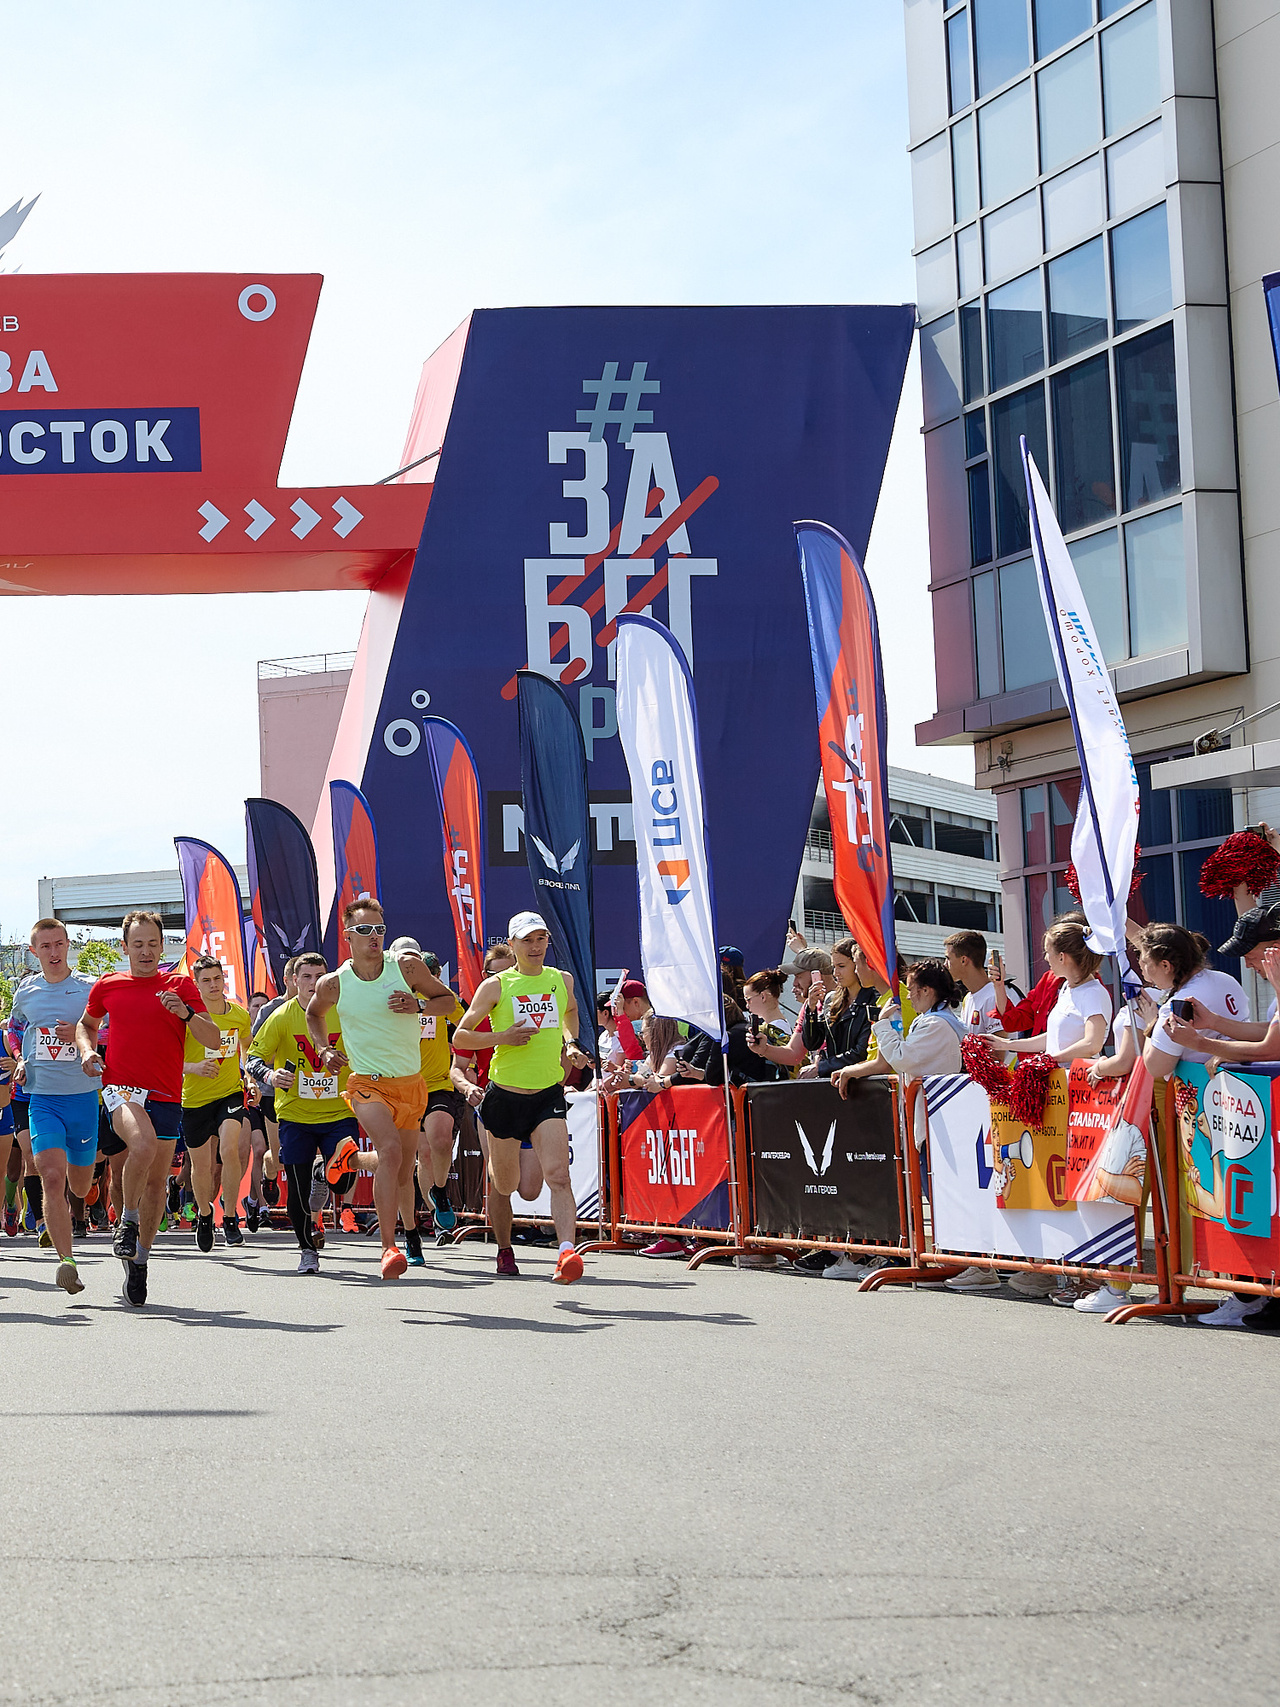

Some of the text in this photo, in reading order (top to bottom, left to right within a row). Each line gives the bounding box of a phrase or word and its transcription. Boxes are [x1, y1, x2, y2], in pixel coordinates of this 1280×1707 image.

[548, 431, 692, 555] ЗА
[518, 1002, 554, 1014] 20045
[302, 1077, 335, 1087] 30402
[1068, 1111, 1111, 1130] СТАЛЬГРАД
[1068, 1135, 1089, 1150] ЕЖИТ
